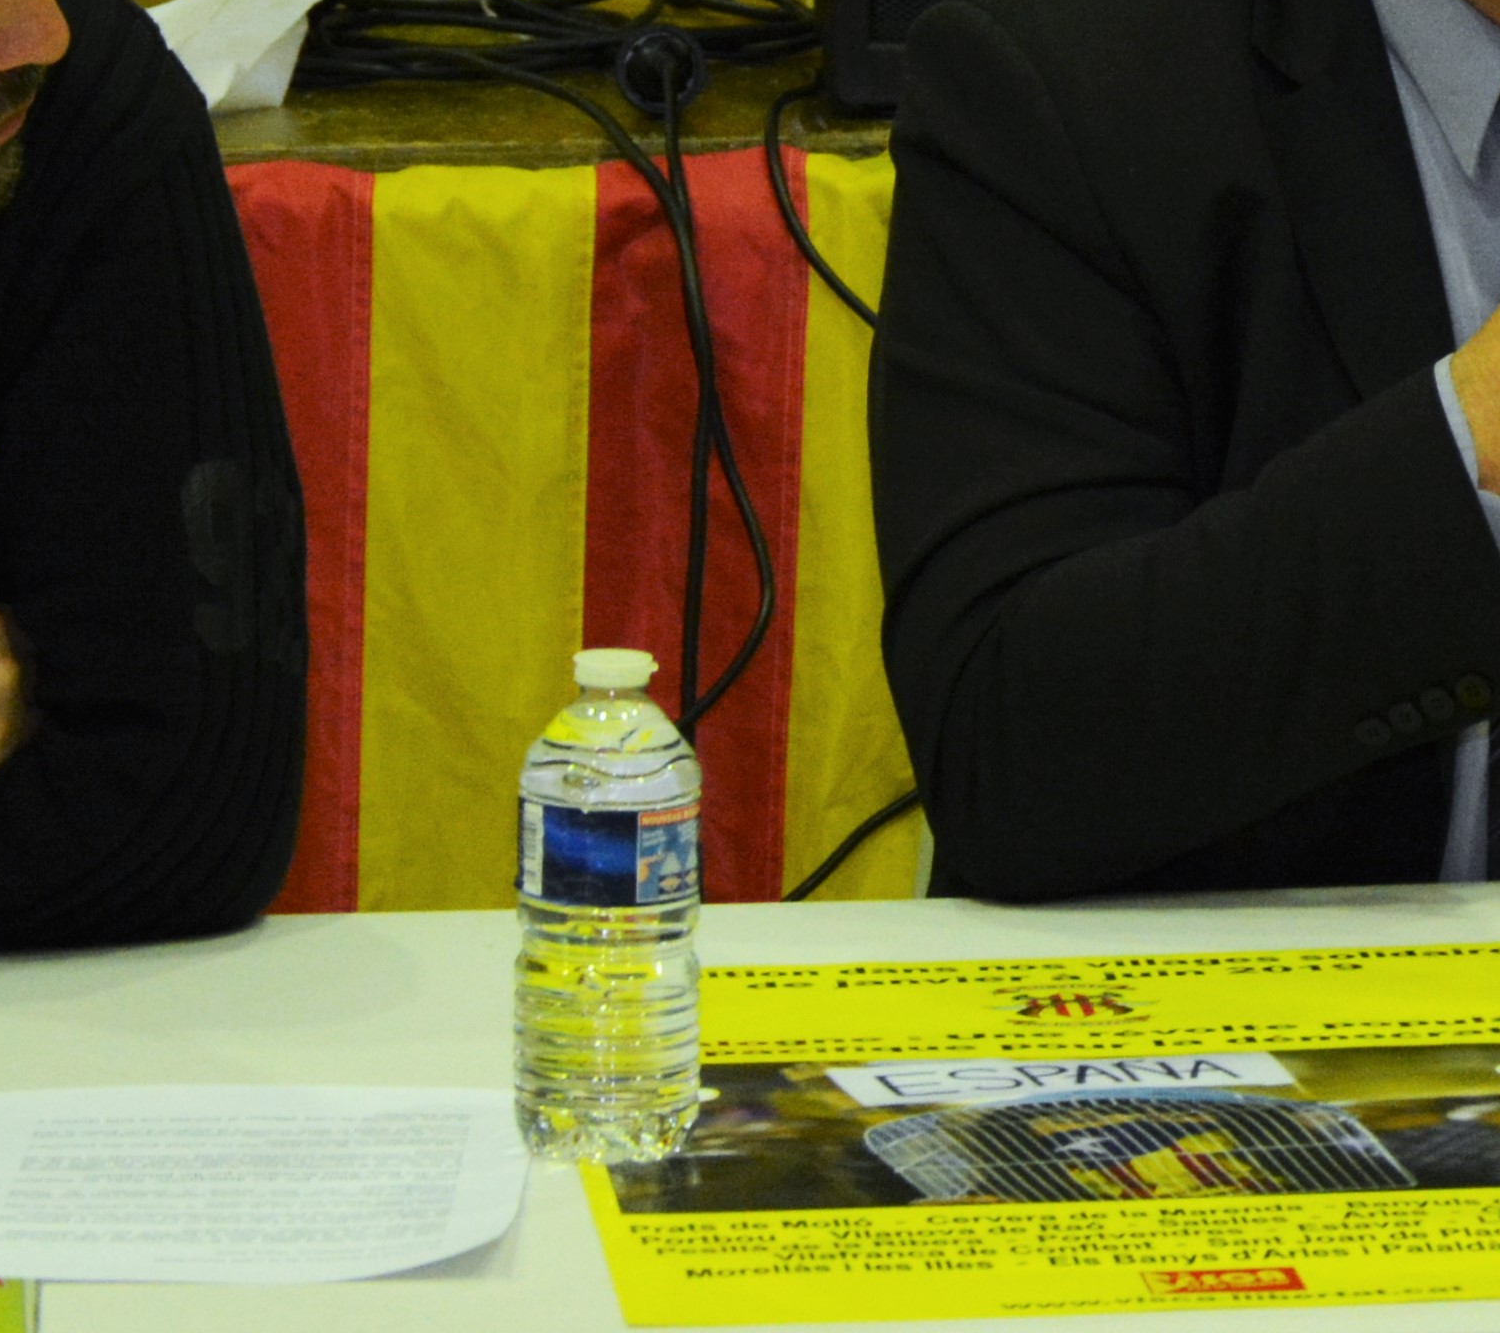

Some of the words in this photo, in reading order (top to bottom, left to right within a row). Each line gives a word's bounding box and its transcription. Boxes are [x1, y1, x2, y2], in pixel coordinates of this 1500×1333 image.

[747, 980, 813, 989] de
[837, 975, 1022, 989] janvier
[1104, 970, 1206, 982] juin
[1226, 962, 1363, 975] 2019
[840, 966, 959, 976] dans
[978, 962, 1067, 973] nos
[1086, 956, 1280, 969] villages
[946, 1031, 1065, 1041] Une
[1089, 1024, 1298, 1039] révolte
[706, 1044, 978, 1058] pacifique
[1002, 1042, 1126, 1053] pour
[1153, 1039, 1203, 1047] la
[875, 1058, 1242, 1097] ESPAÑA
[630, 1222, 717, 1234] Prats
[730, 1221, 769, 1231] de
[781, 1217, 874, 1230] Molló
[926, 1212, 1058, 1225] Cervera
[1069, 1211, 1108, 1221] de
[1120, 1209, 1149, 1219] la
[1159, 1204, 1304, 1217] Marenda
[641, 1234, 777, 1245] Portbou
[830, 1228, 977, 1240] Vilanova
[988, 1225, 1028, 1235] de
[774, 1249, 946, 1262] Vilafranca
[958, 1246, 998, 1257] de
[1207, 1236, 1285, 1248] Sant
[1297, 1233, 1378, 1245] Joan
[1390, 1230, 1429, 1240] de
[781, 1242, 820, 1252] de
[873, 1236, 983, 1248] Ribera
[1037, 1227, 1244, 1243] Portvendres
[864, 1261, 913, 1272] les
[1048, 1255, 1101, 1267] Els
[1112, 1252, 1220, 1267] Banys
